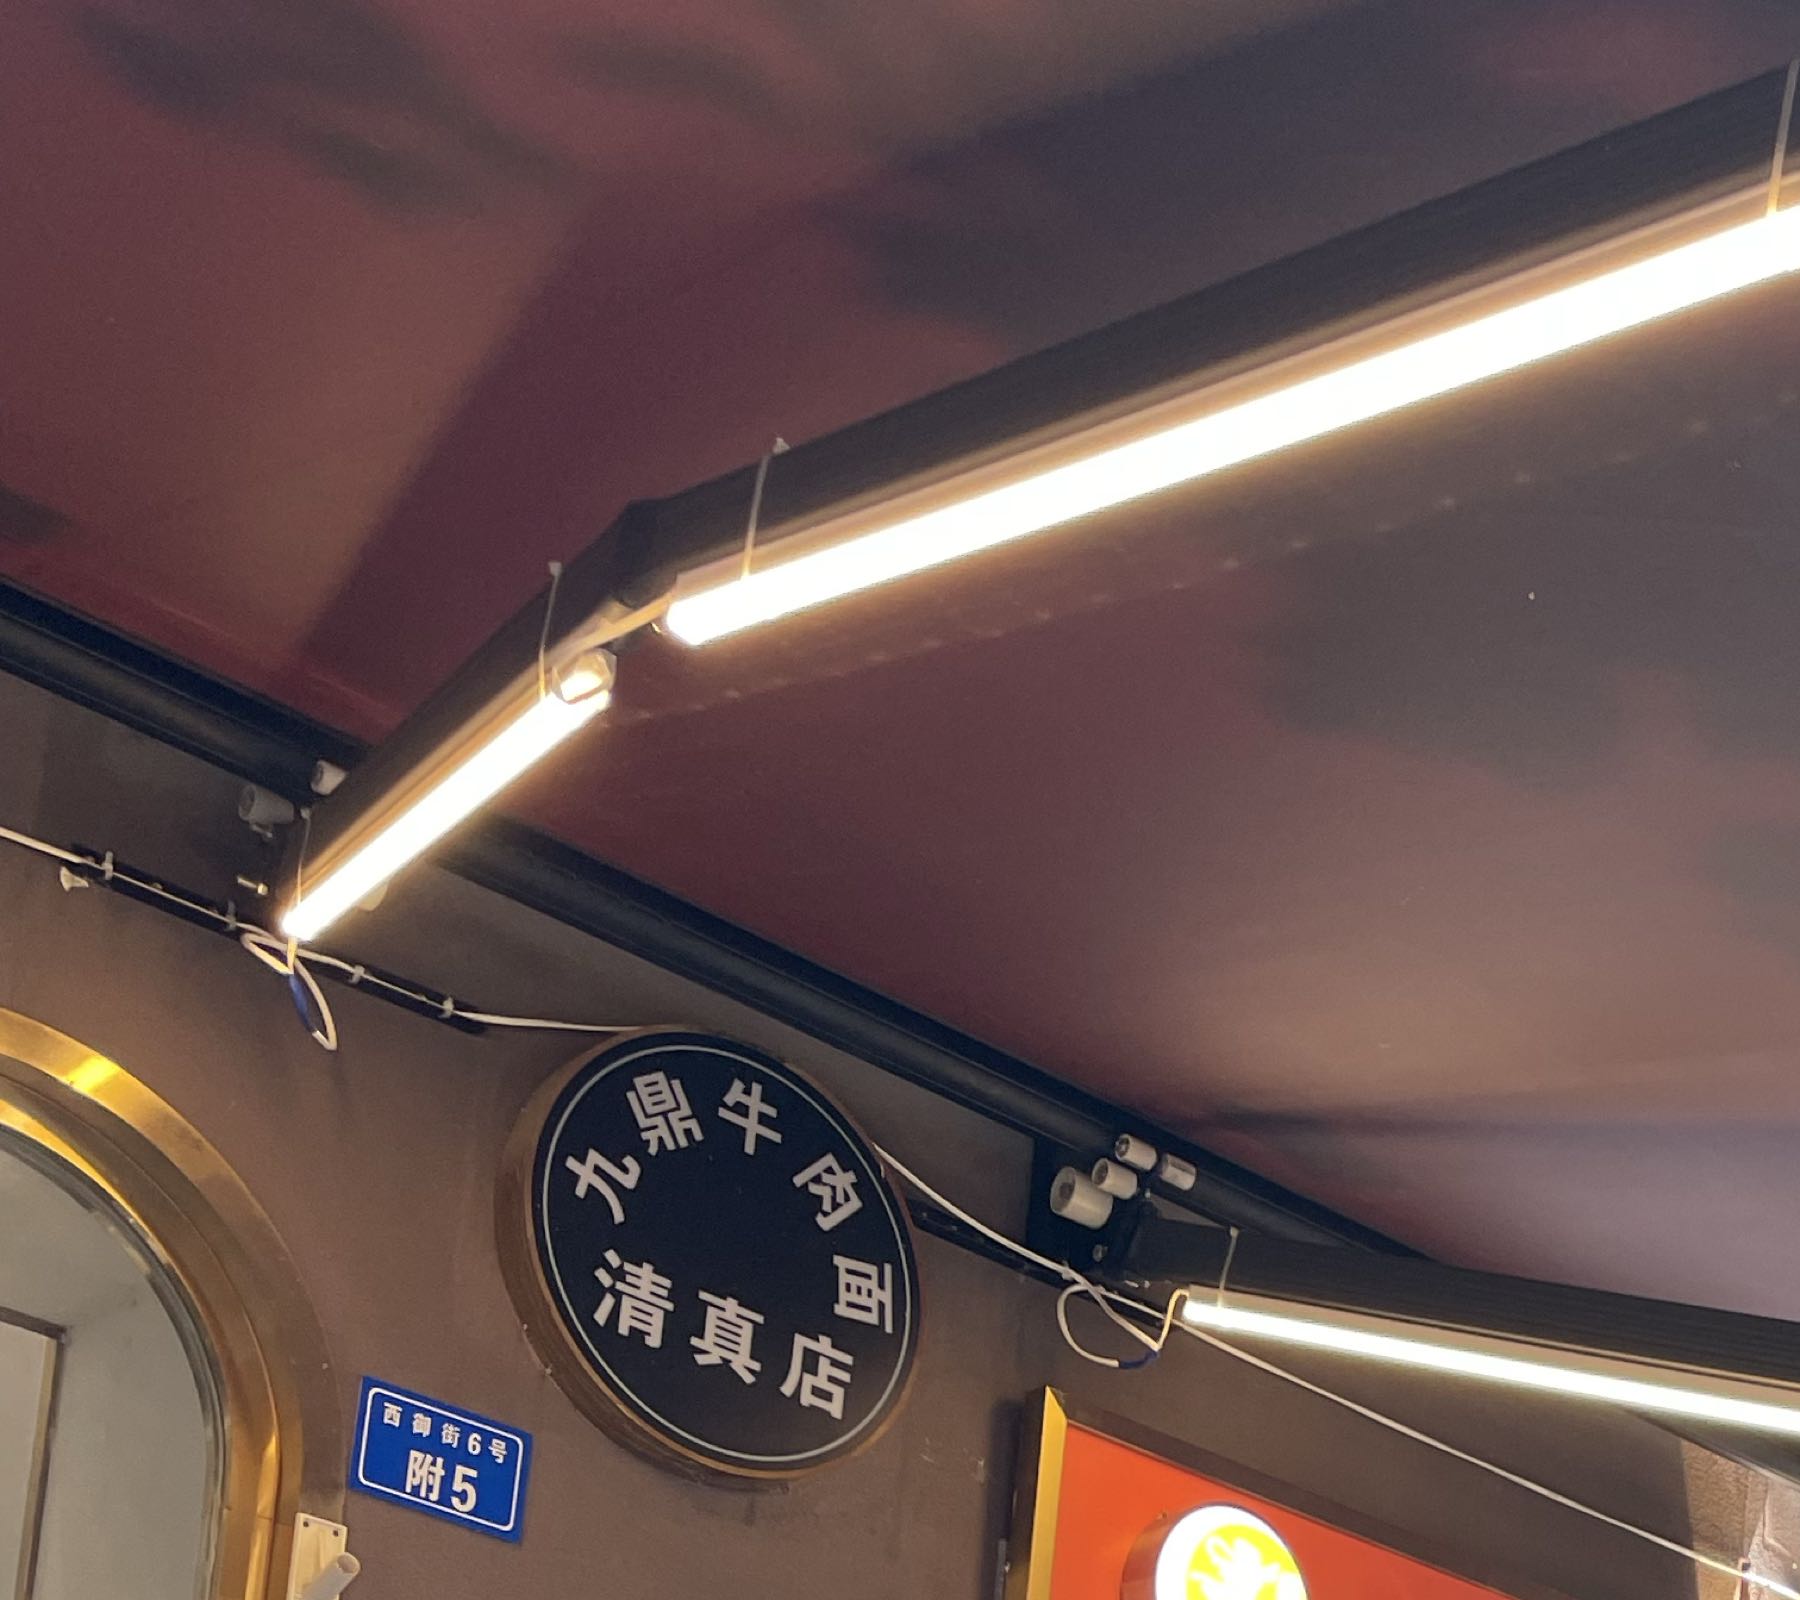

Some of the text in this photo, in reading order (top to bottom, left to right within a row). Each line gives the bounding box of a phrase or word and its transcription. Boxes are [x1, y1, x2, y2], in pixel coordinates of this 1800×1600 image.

[565, 1070, 893, 1335] 九鼎牛肉面
[594, 1248, 854, 1420] 清真店
[382, 1402, 509, 1464] 西御街6号
[404, 1448, 479, 1514] 附5
